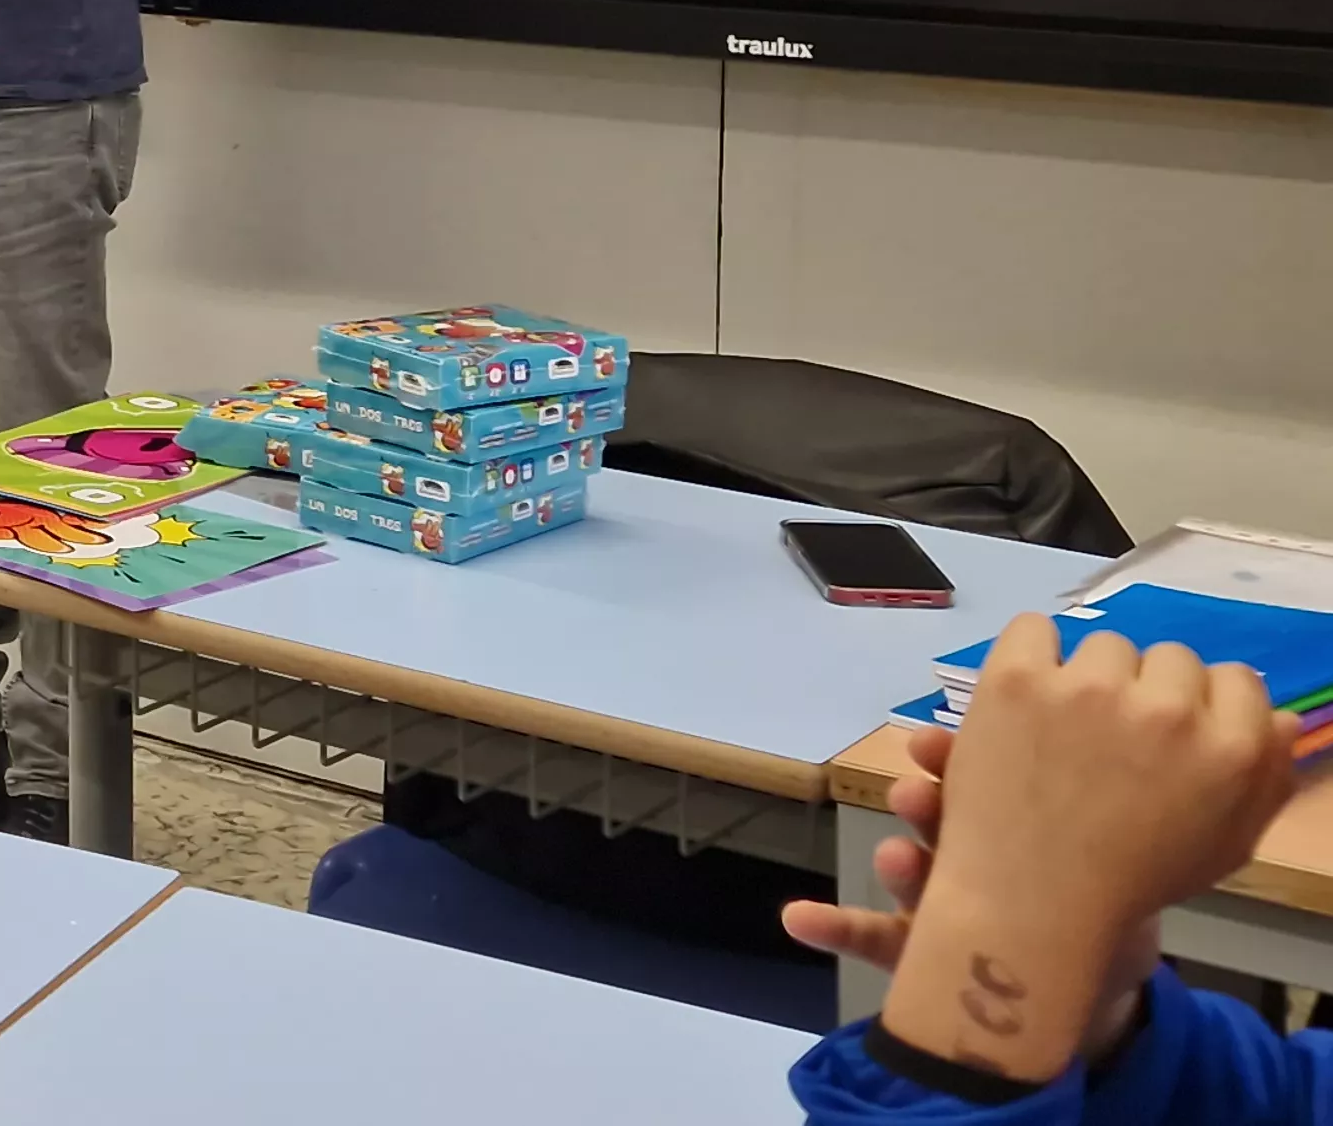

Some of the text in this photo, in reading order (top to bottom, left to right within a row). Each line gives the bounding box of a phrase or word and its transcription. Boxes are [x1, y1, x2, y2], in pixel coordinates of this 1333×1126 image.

[726, 34, 815, 60] traulux
[358, 405, 383, 423] DOS
[334, 505, 359, 522] DOS
